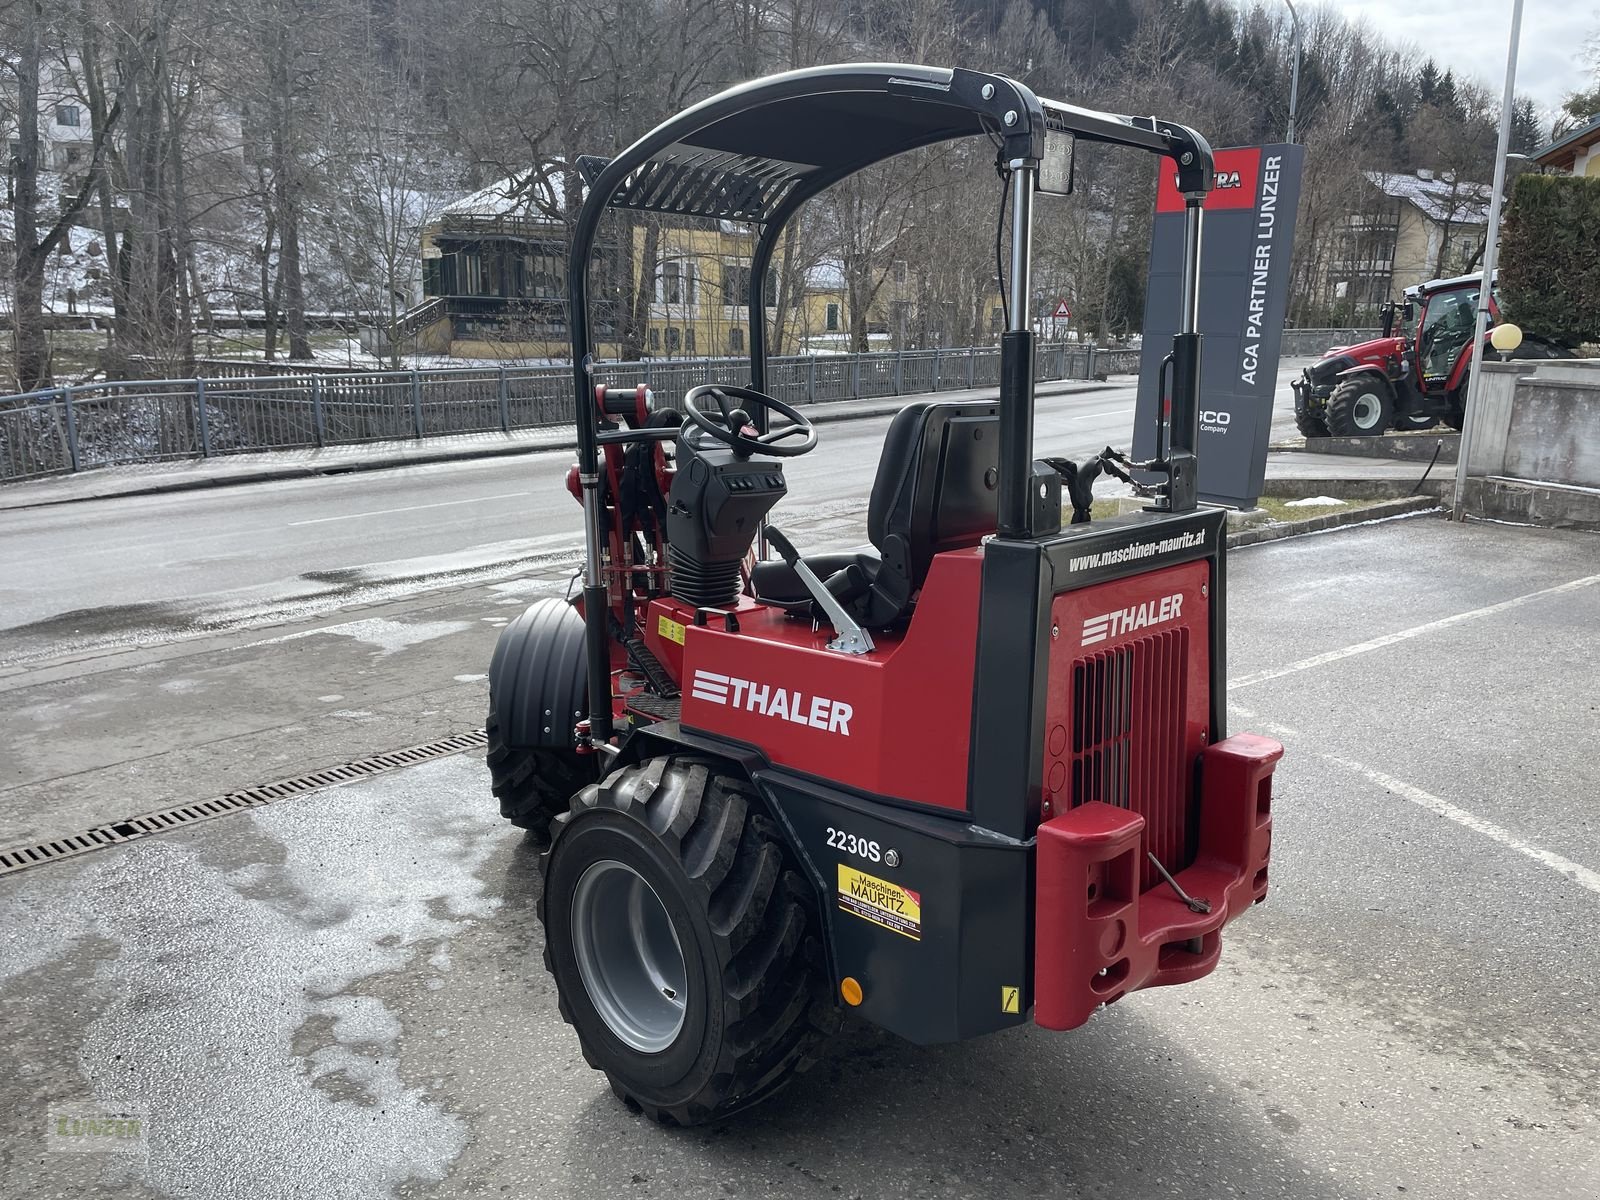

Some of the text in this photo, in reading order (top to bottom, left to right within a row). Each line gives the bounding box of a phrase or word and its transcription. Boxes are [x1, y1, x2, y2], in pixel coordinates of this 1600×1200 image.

[1241, 155, 1282, 385] ACA PARTNER LUNZER
[1200, 424, 1228, 434] Company
[1069, 528, 1206, 572] www.maschinen-mauritz.at
[1110, 593, 1184, 637] THALER
[729, 677, 854, 736] THALER
[826, 827, 881, 863] 2230S
[859, 874, 904, 899] Maschinen-
